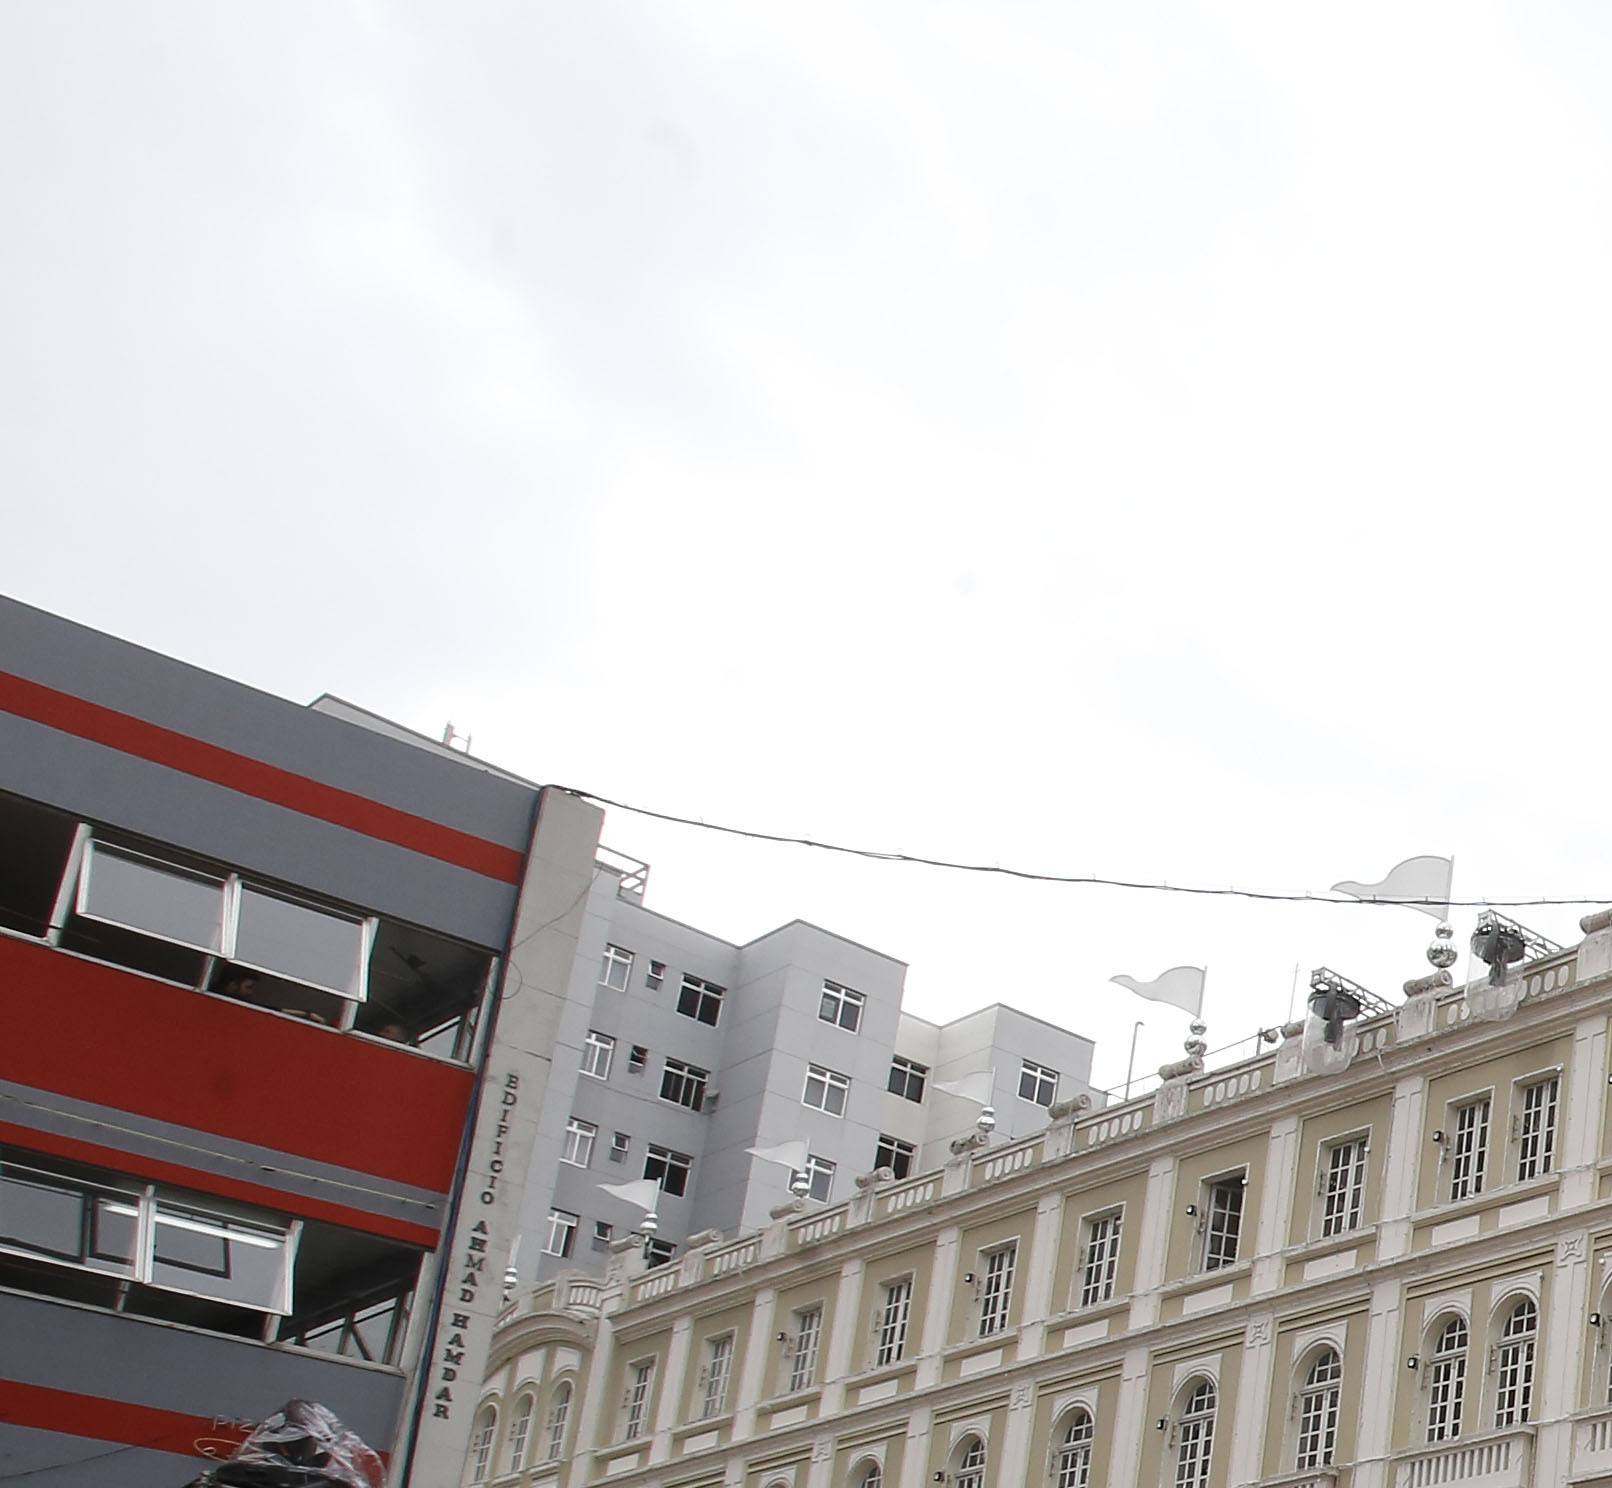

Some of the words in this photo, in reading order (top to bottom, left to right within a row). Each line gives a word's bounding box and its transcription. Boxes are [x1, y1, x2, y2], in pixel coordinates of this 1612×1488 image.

[481, 1074, 519, 1205] EDIFICIO
[459, 1220, 488, 1303] AHMAD
[433, 1312, 470, 1420] HAMDAR
